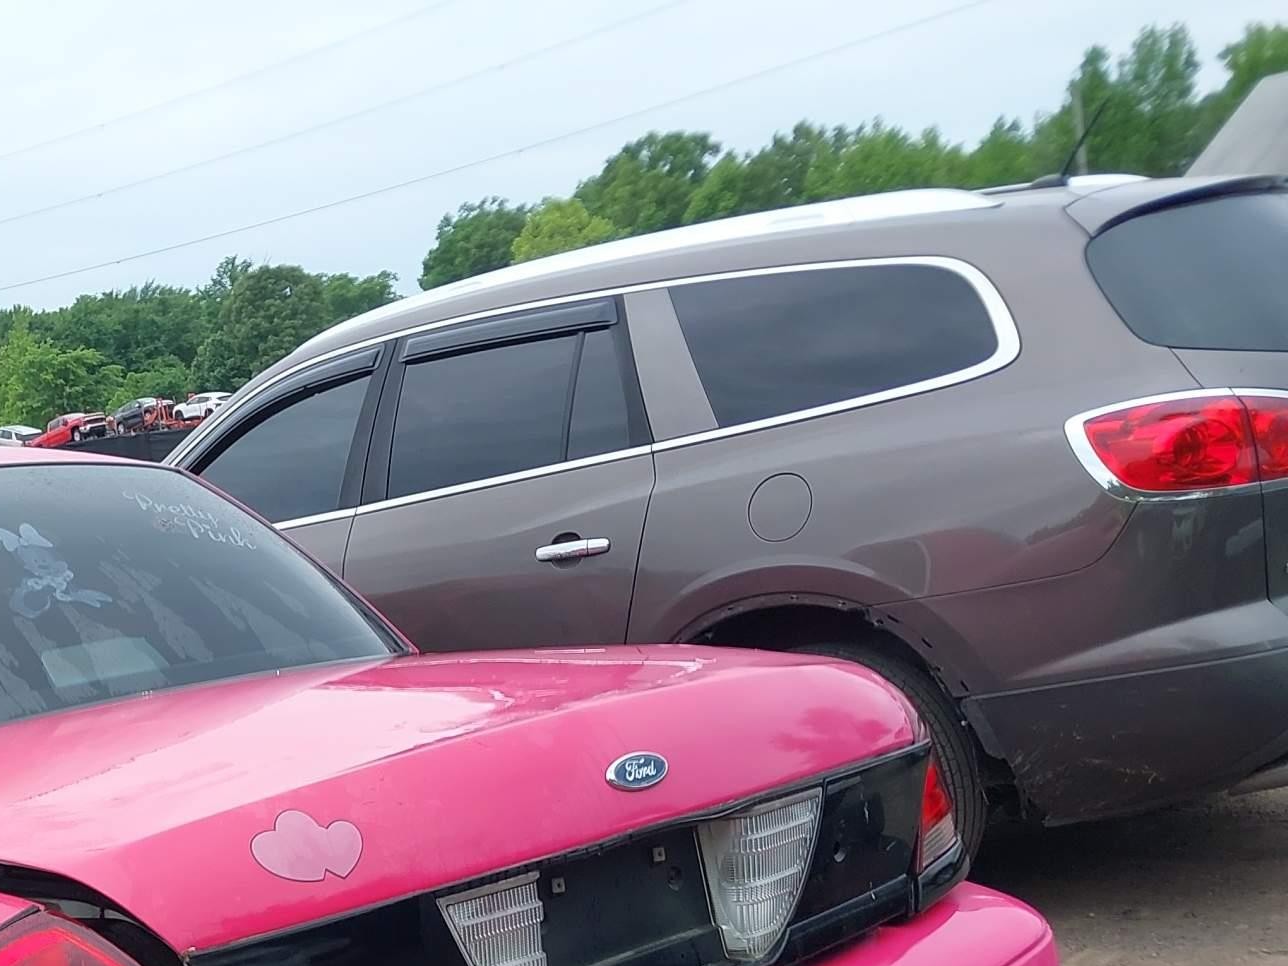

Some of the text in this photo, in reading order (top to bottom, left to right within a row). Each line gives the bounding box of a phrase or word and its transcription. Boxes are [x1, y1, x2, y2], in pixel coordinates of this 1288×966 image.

[122, 490, 219, 529] Pretty
[174, 516, 257, 550] Pink
[624, 757, 658, 782] Ford
